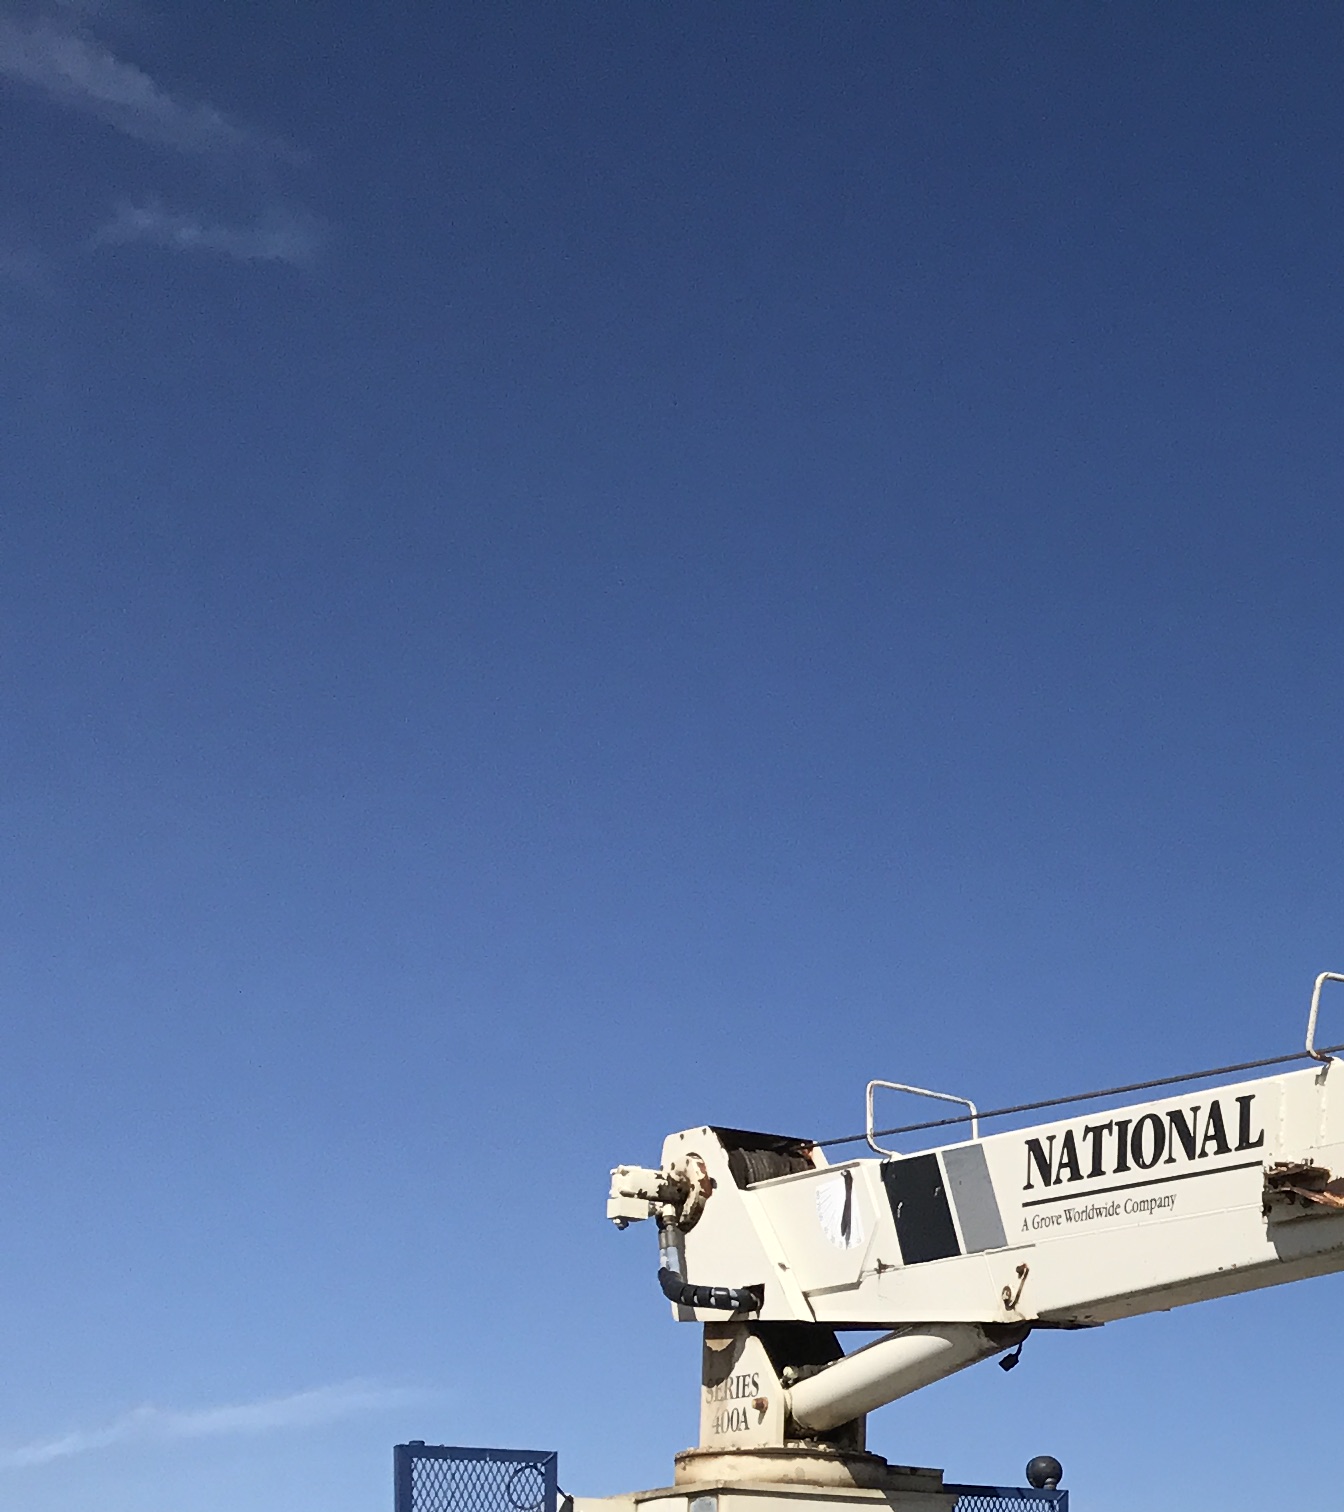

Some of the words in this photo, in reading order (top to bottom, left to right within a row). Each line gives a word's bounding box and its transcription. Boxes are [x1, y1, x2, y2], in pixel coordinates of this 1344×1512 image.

[1022, 1094, 1264, 1190] NATIONAL
[1021, 1217, 1030, 1232] A
[1032, 1213, 1062, 1229] Grove
[1064, 1200, 1121, 1223] Worldwide
[1124, 1194, 1177, 1215] Company
[705, 1372, 760, 1404] SERIES
[712, 1406, 750, 1435] 400A
